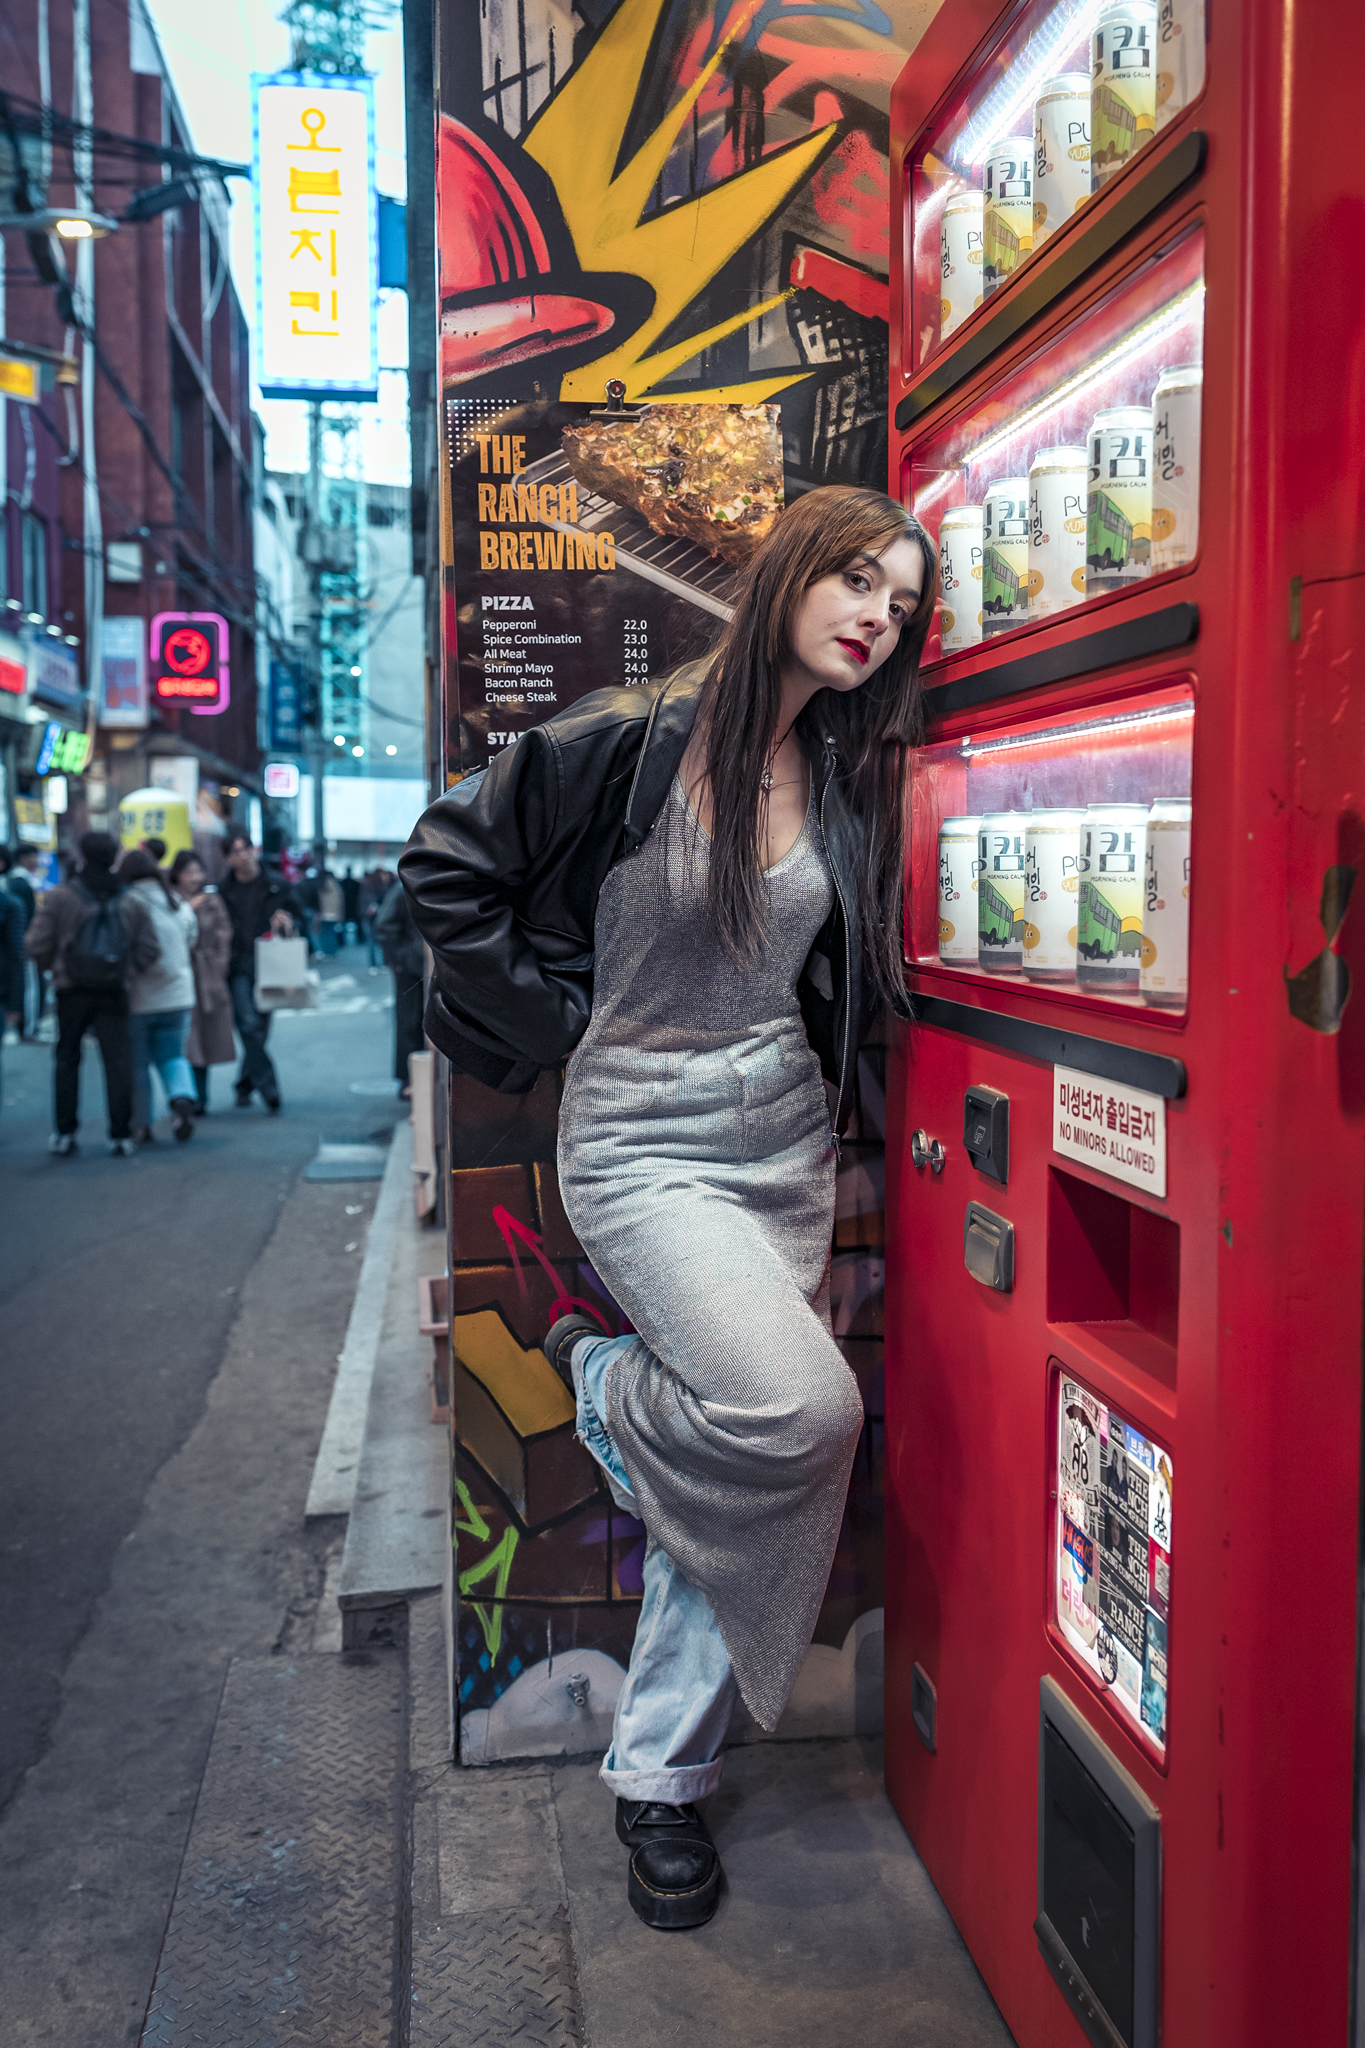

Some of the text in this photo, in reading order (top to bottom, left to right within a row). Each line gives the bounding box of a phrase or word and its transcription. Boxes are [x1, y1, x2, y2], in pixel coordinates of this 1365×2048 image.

[476, 434, 527, 475] THE
[478, 483, 578, 523] RANCH
[480, 531, 617, 570] BREWING
[481, 596, 535, 611] PIZZA
[482, 619, 648, 632] Pepperoni 22.0
[483, 633, 648, 646] Spice Combination 23.0
[484, 648, 648, 659] All Meat 24.0
[484, 663, 649, 675] Shrimp Mayo 24.0
[485, 677, 649, 688] Bacon Ranch 240
[485, 692, 557, 702] Cheese Steak
[1060, 1083, 1156, 1146] 미성년자 출입금지
[1060, 1121, 1156, 1174] NO MINORS ALLOWED
[1129, 1470, 1149, 1500] THE
[1127, 1488, 1148, 1520] NCH
[1128, 1534, 1148, 1566] THE
[1128, 1555, 1147, 1587] NCH
[1126, 1599, 1145, 1630] THE
